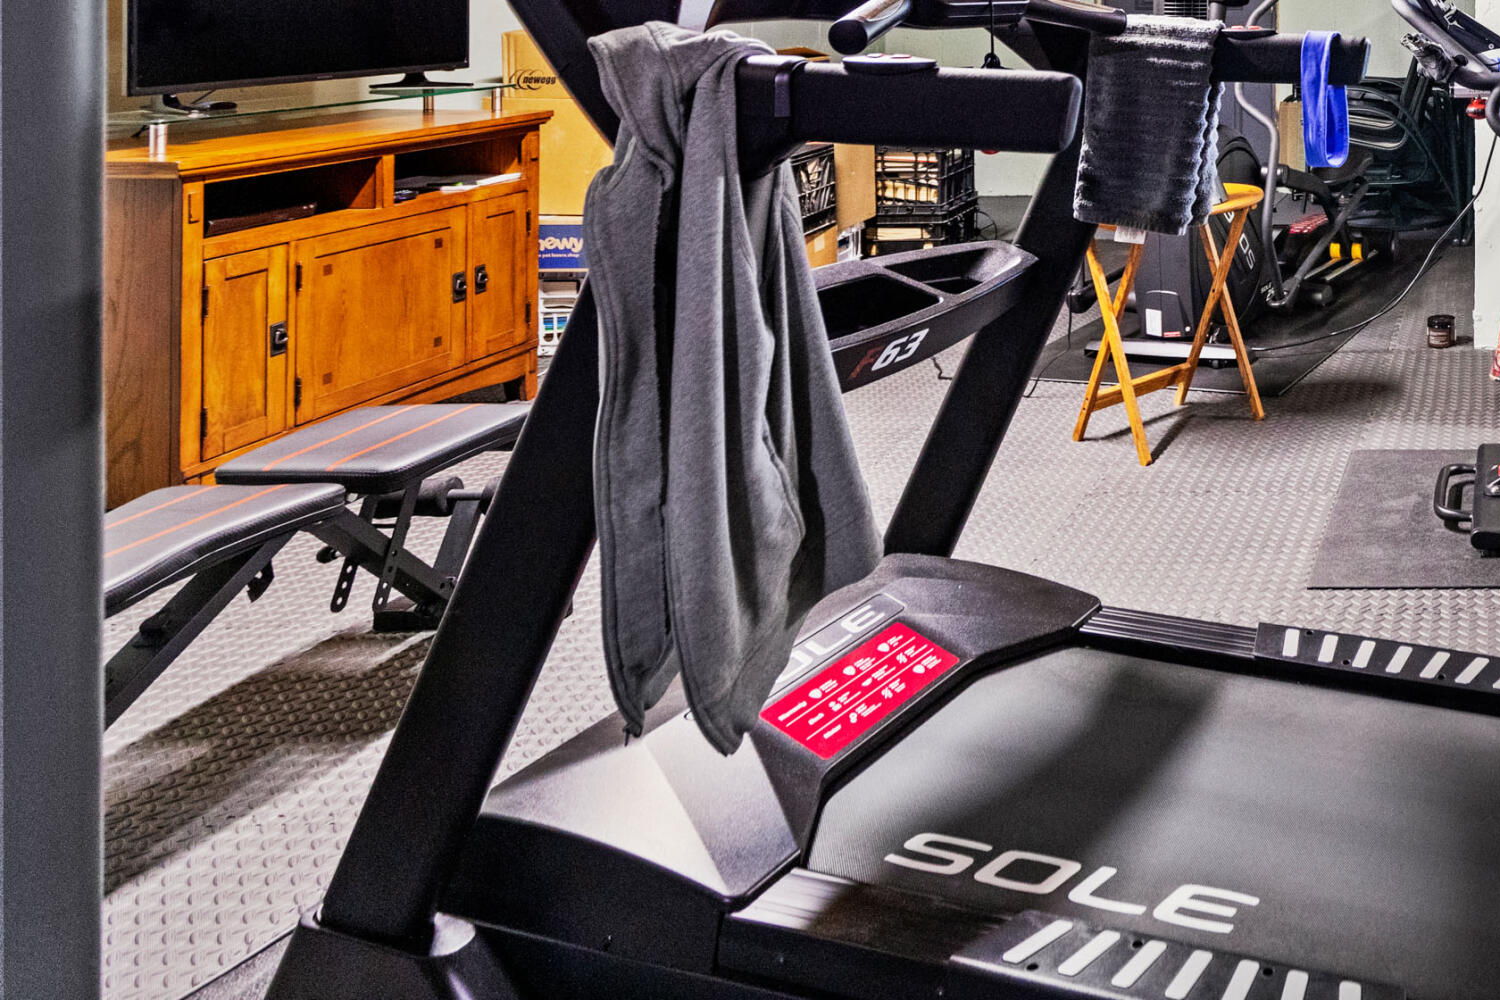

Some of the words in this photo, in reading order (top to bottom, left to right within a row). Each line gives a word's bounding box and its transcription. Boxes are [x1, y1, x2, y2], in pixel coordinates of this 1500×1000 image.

[522, 76, 557, 85] newegg
[538, 236, 584, 253] ewy
[776, 603, 886, 685] OLE
[884, 832, 1260, 934] SOLE
